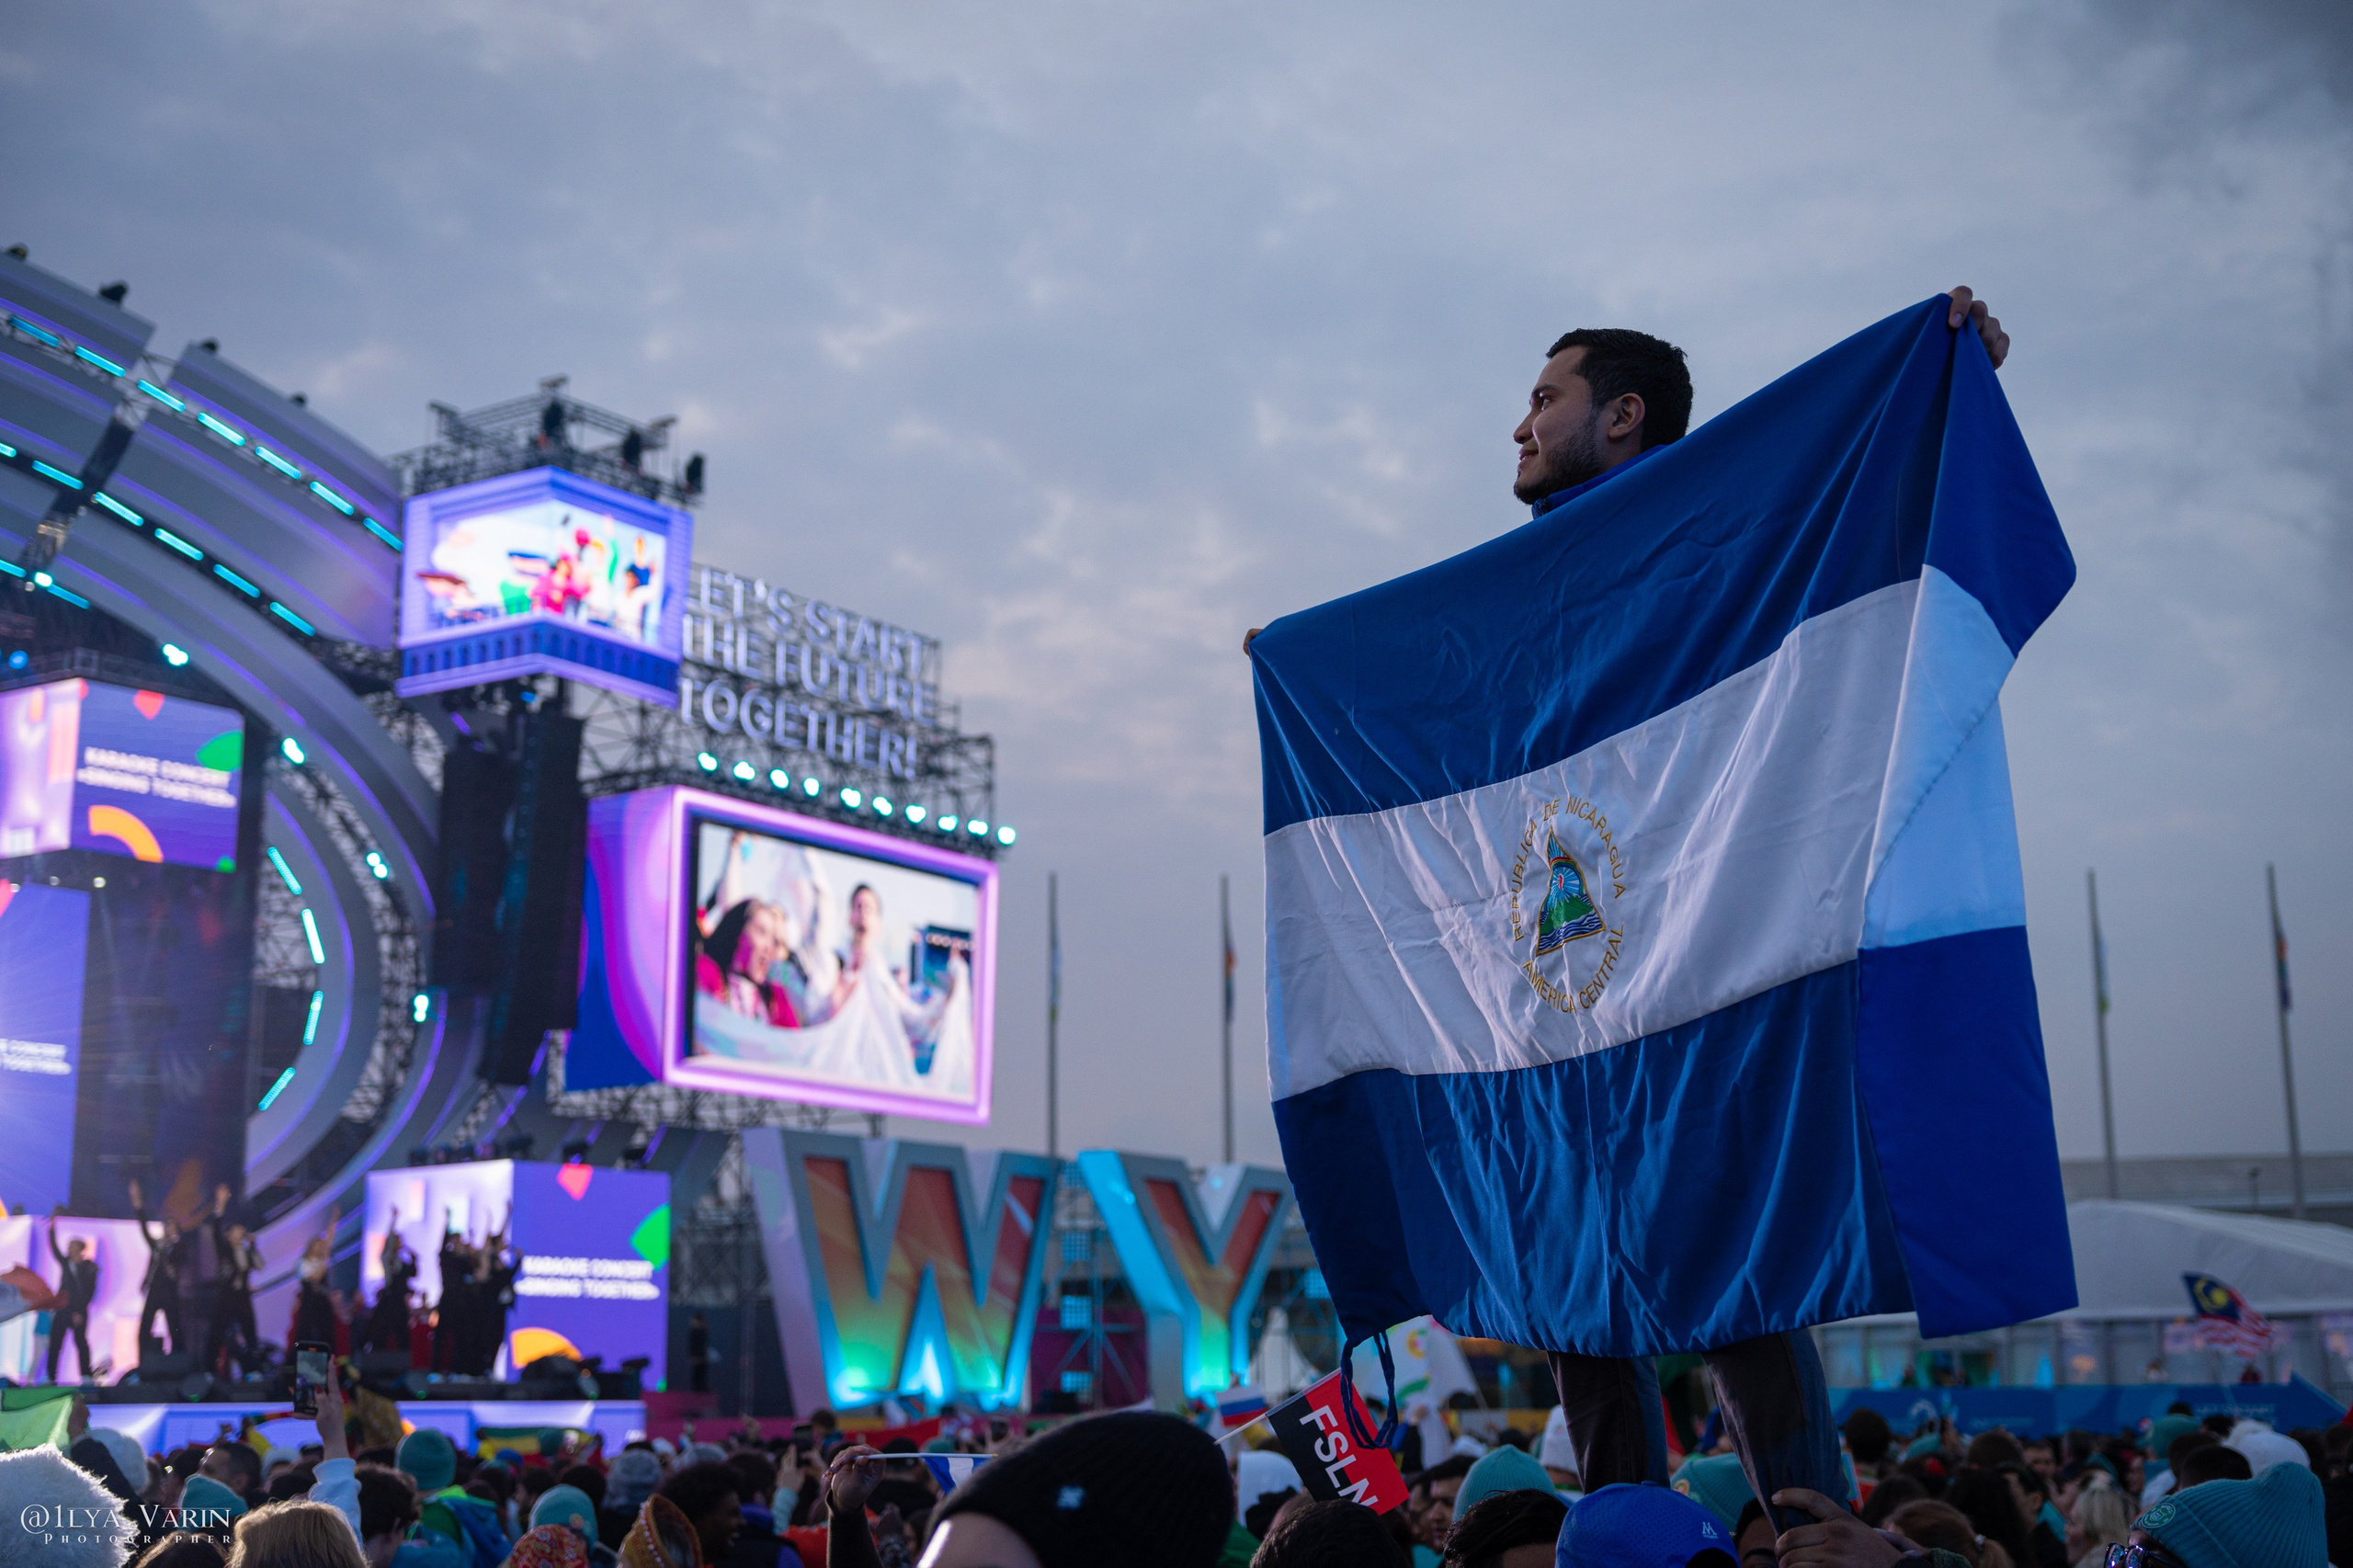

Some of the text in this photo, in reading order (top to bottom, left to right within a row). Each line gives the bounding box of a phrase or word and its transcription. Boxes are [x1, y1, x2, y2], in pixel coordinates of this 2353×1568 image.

[775, 638, 938, 729] FUTURE
[804, 597, 922, 683] START
[1510, 796, 1626, 942] REPUBLICA DE NICARAGUA
[1522, 924, 1624, 1015] AMERICA CENTRAL
[1299, 1404, 1379, 1507] FSLN
